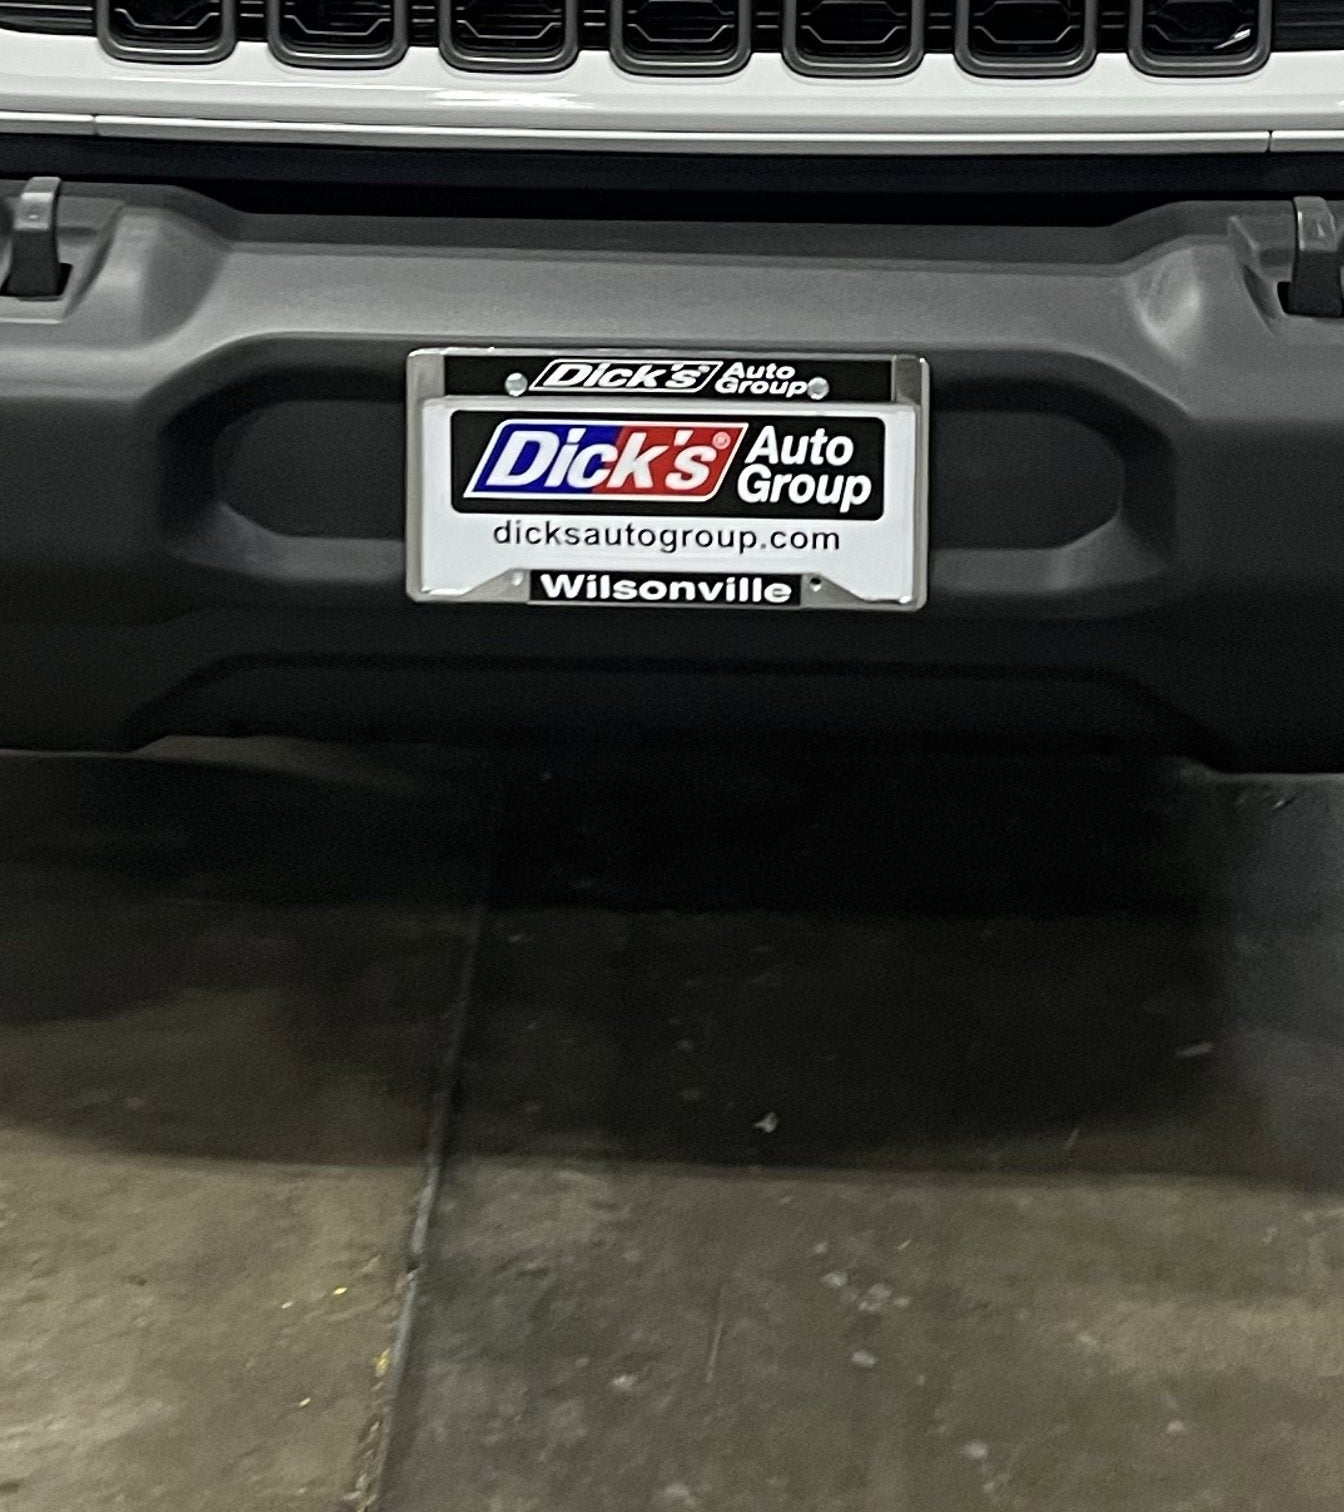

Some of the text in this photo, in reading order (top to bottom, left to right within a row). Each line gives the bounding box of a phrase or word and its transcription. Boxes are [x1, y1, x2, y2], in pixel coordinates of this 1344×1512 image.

[542, 361, 702, 388] Dick's
[721, 361, 796, 380] Auto
[714, 377, 808, 398] Group
[485, 427, 718, 491] Dick's
[744, 425, 855, 467] Auto
[736, 463, 873, 514] Group
[493, 521, 840, 554] dicksautogroup.com
[540, 573, 793, 604] Wilsonville
